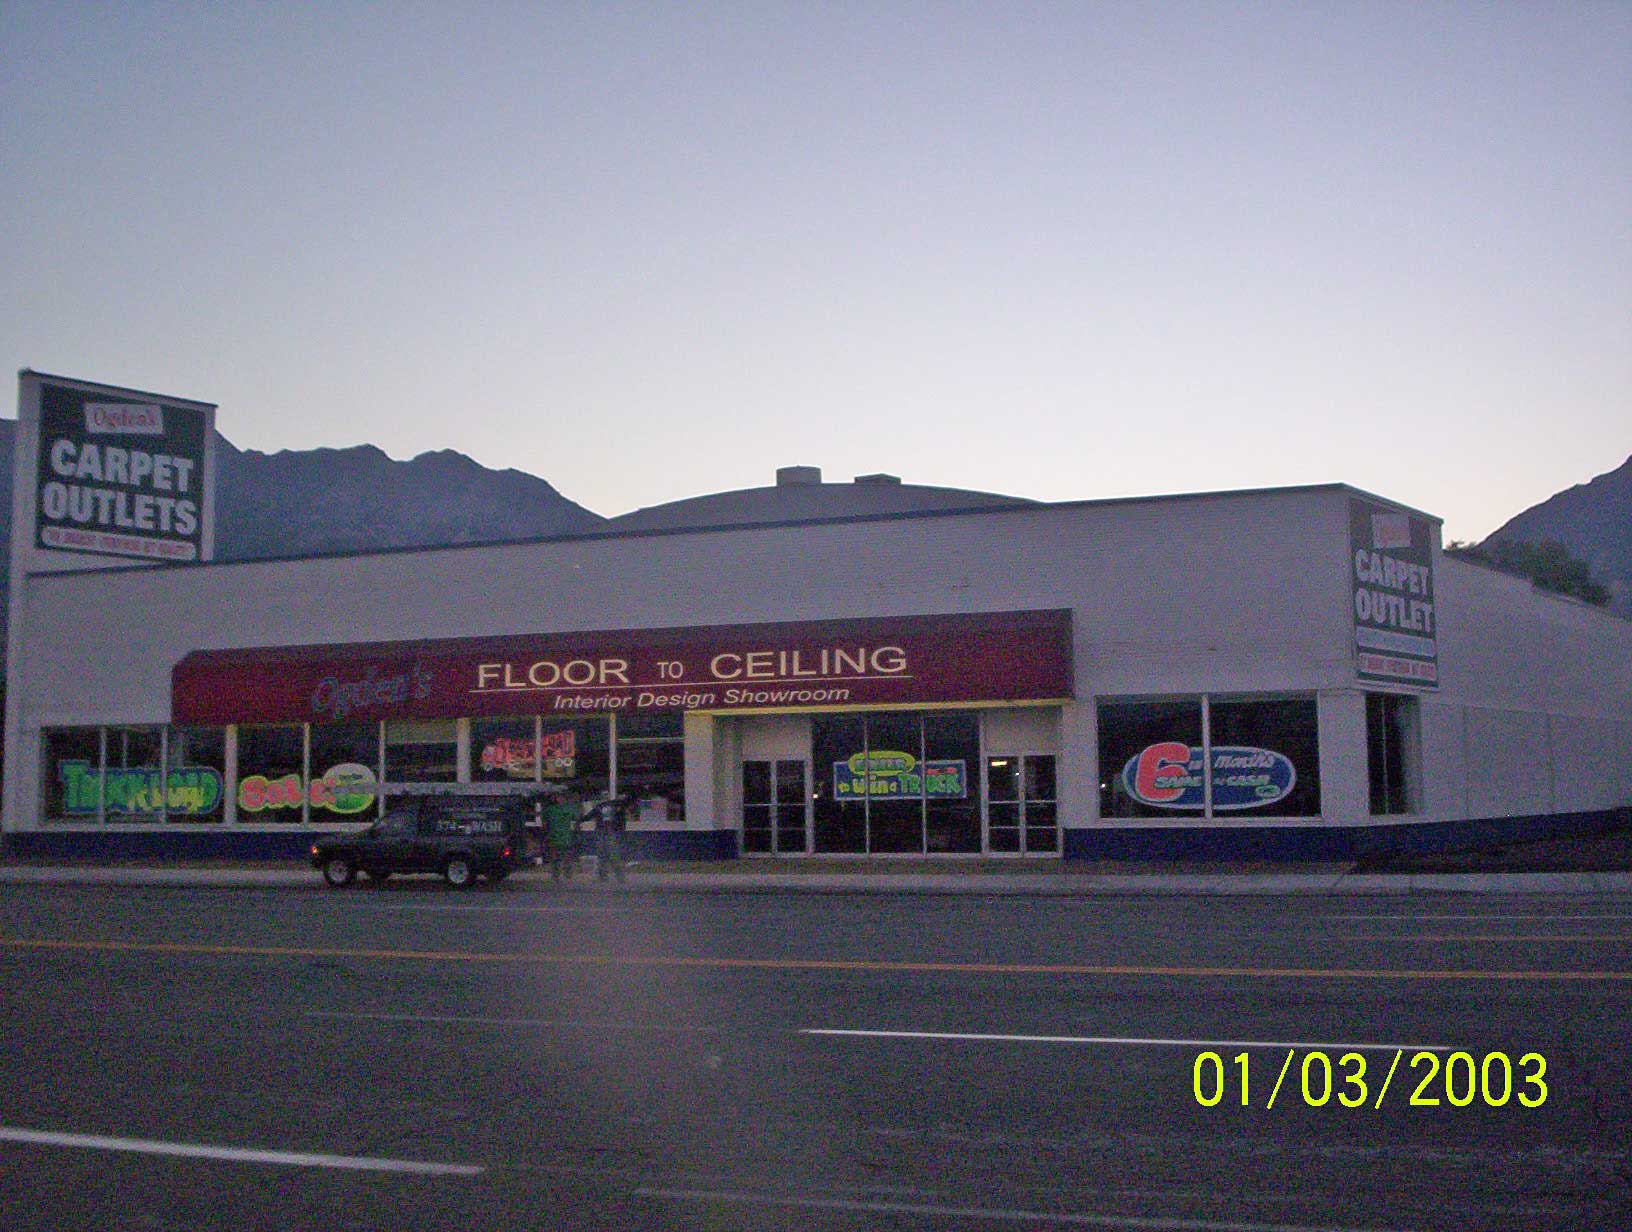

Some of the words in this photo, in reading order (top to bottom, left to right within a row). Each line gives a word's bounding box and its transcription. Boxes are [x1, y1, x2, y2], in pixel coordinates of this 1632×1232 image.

[51, 440, 194, 492] CARPET
[43, 481, 198, 535] OUTLETS
[1355, 549, 1430, 595] CARPET
[1355, 587, 1433, 633] OUTLET
[477, 657, 631, 688] FLOOR
[657, 661, 684, 680] TO
[710, 646, 907, 679] CEILING
[553, 692, 633, 710] Interior
[637, 689, 716, 709] Design
[724, 686, 851, 705] Showroom
